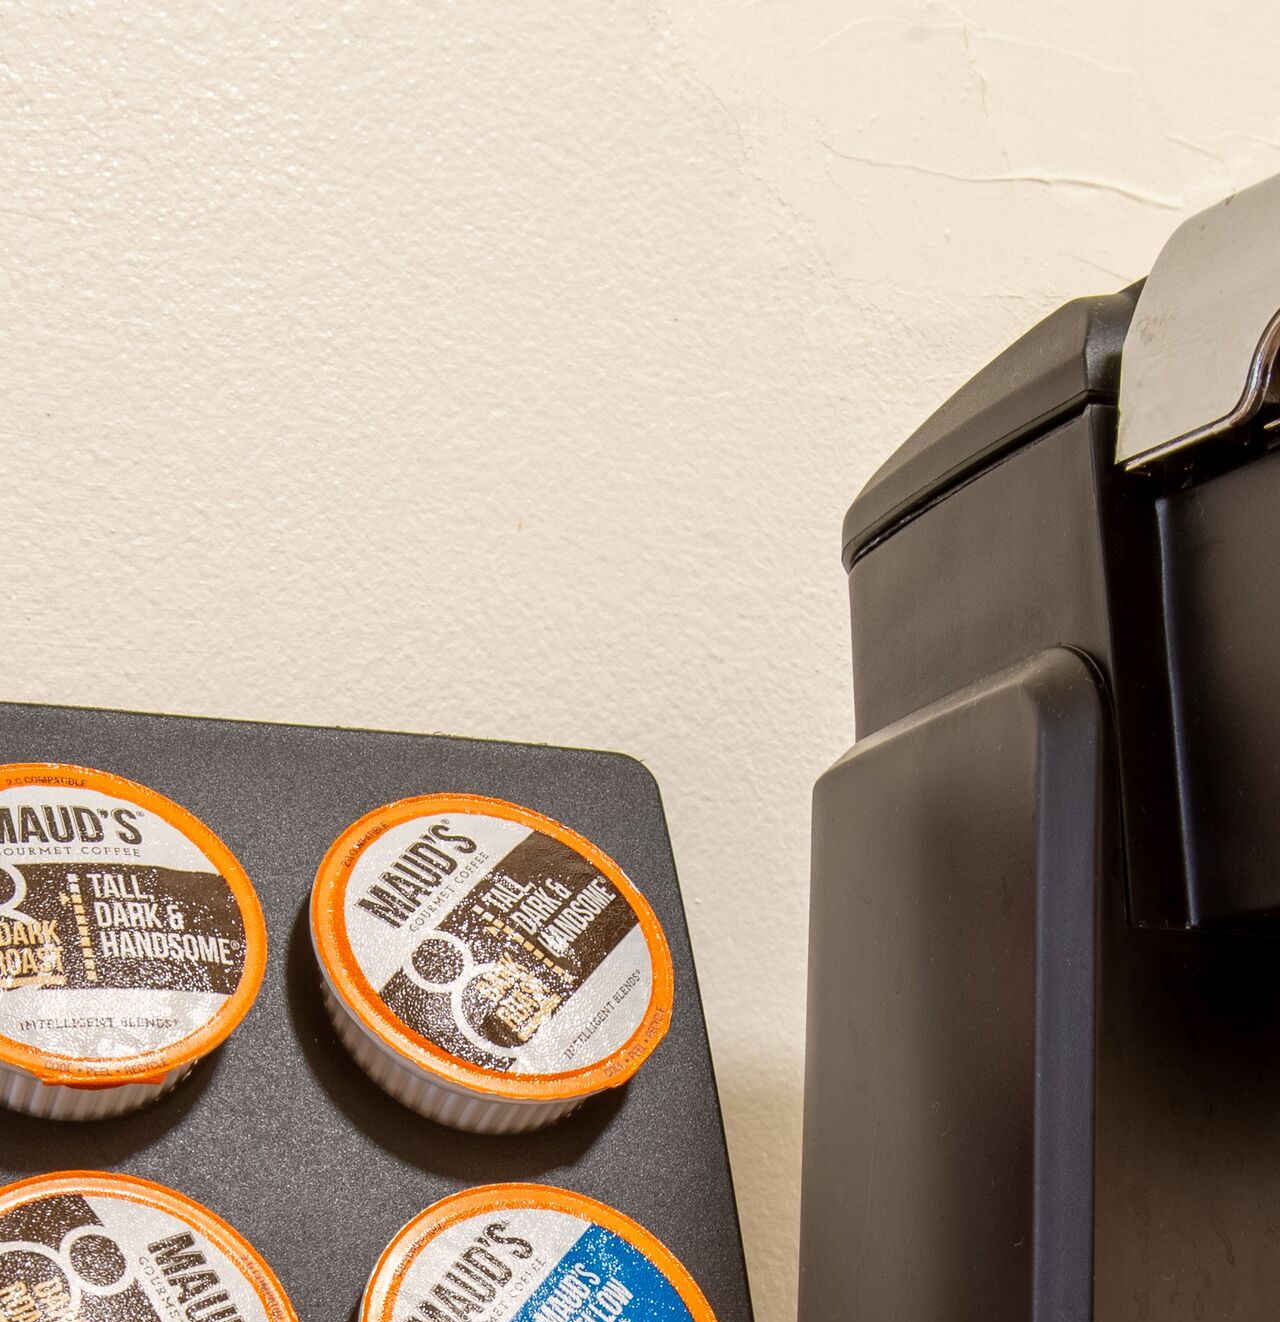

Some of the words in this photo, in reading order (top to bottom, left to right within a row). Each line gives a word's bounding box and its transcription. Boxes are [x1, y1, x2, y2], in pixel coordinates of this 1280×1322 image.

[81, 847, 142, 858] COFFEE
[86, 873, 155, 901] TALL,
[354, 824, 477, 929] MAUD'S
[409, 884, 456, 933] GOURMET
[454, 851, 490, 885] COFFEE
[94, 901, 163, 929] DARK
[167, 903, 185, 931] &
[510, 887, 563, 936] DARK
[545, 878, 572, 899] &
[537, 880, 617, 959] HANDSOME
[99, 930, 235, 966] HANDSOME
[20, 1017, 114, 1031] INTELLIGENT
[121, 1017, 174, 1029] BLENDS
[563, 1001, 615, 1060] INTELLIGENT
[612, 971, 640, 1004] BLENDS
[125, 1059, 170, 1075] RECYCLE
